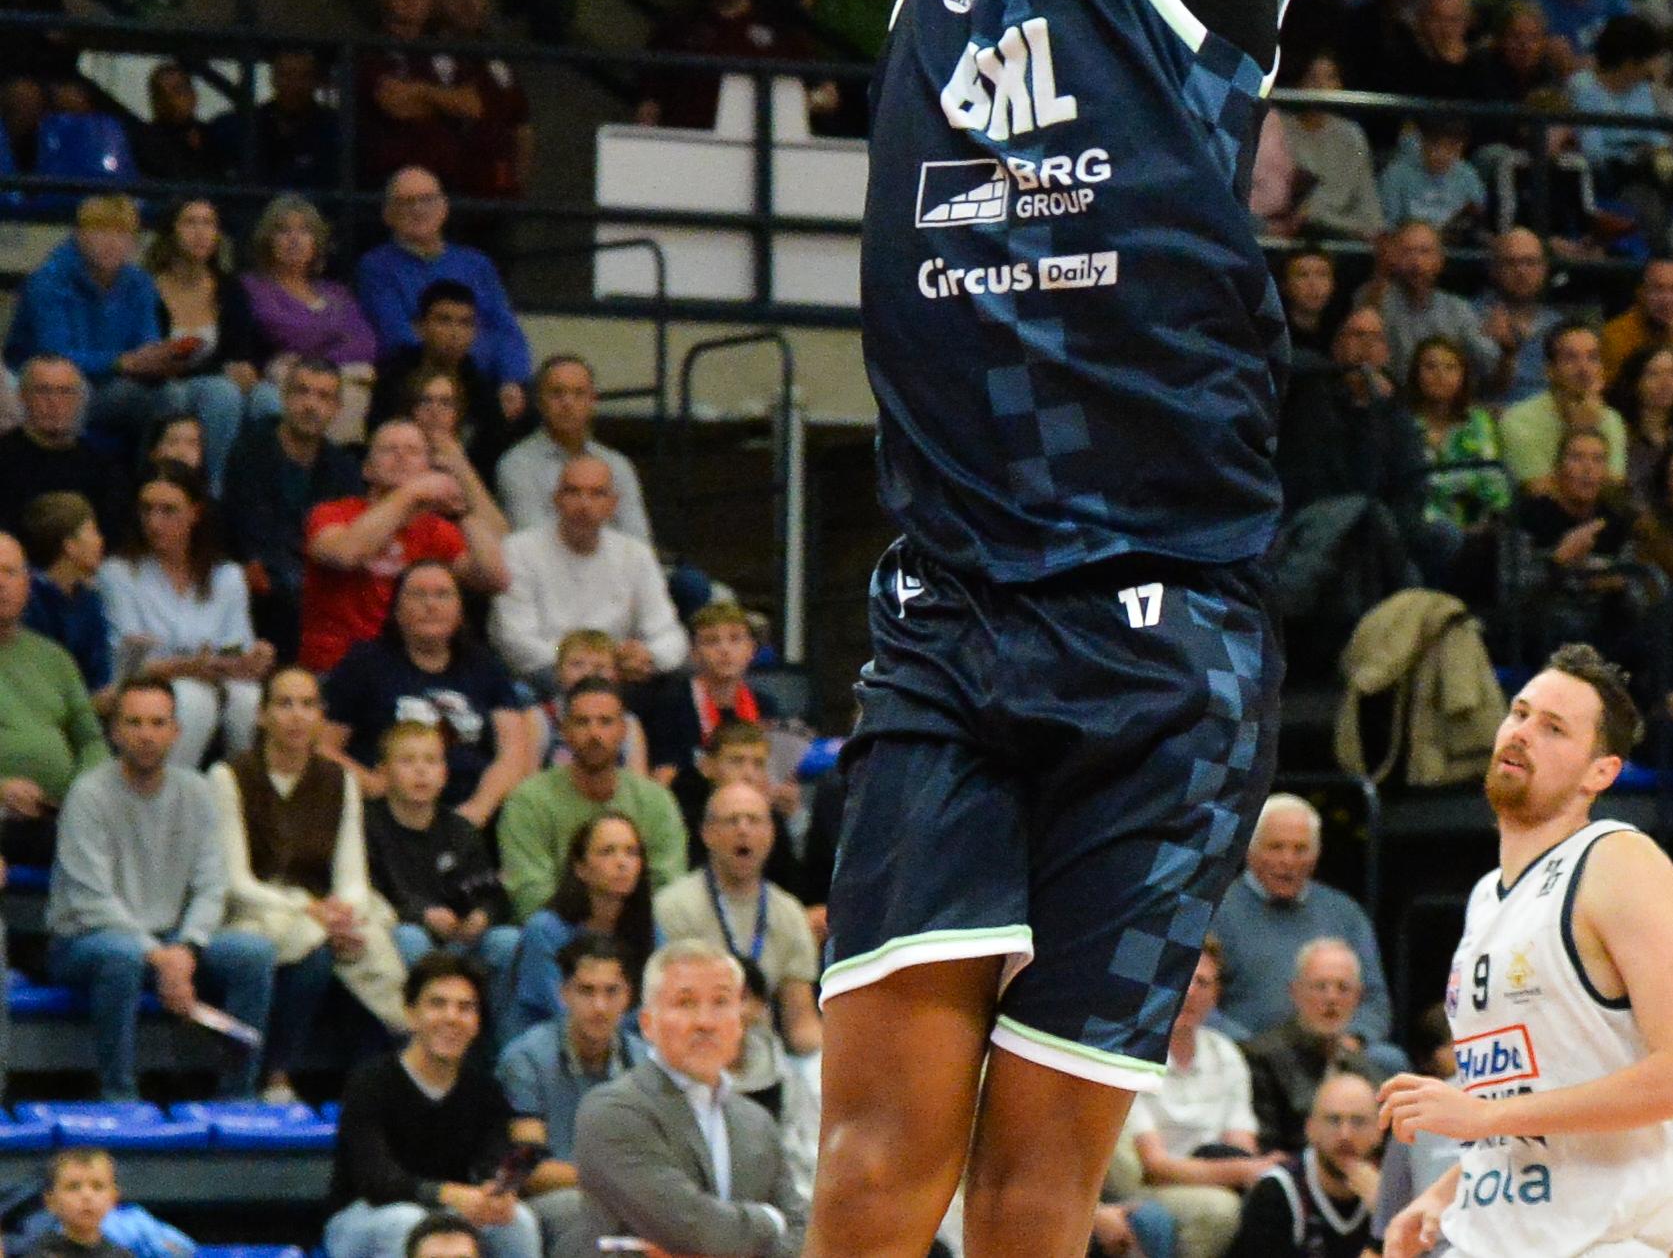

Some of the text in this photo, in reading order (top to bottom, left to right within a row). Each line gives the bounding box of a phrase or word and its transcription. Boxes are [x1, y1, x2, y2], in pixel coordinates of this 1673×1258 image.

[1007, 148, 1112, 191] BRG
[1016, 189, 1095, 219] GROUP
[918, 257, 1107, 299] Circus Daily
[1118, 582, 1163, 629] 17
[1472, 954, 1490, 1010] 9
